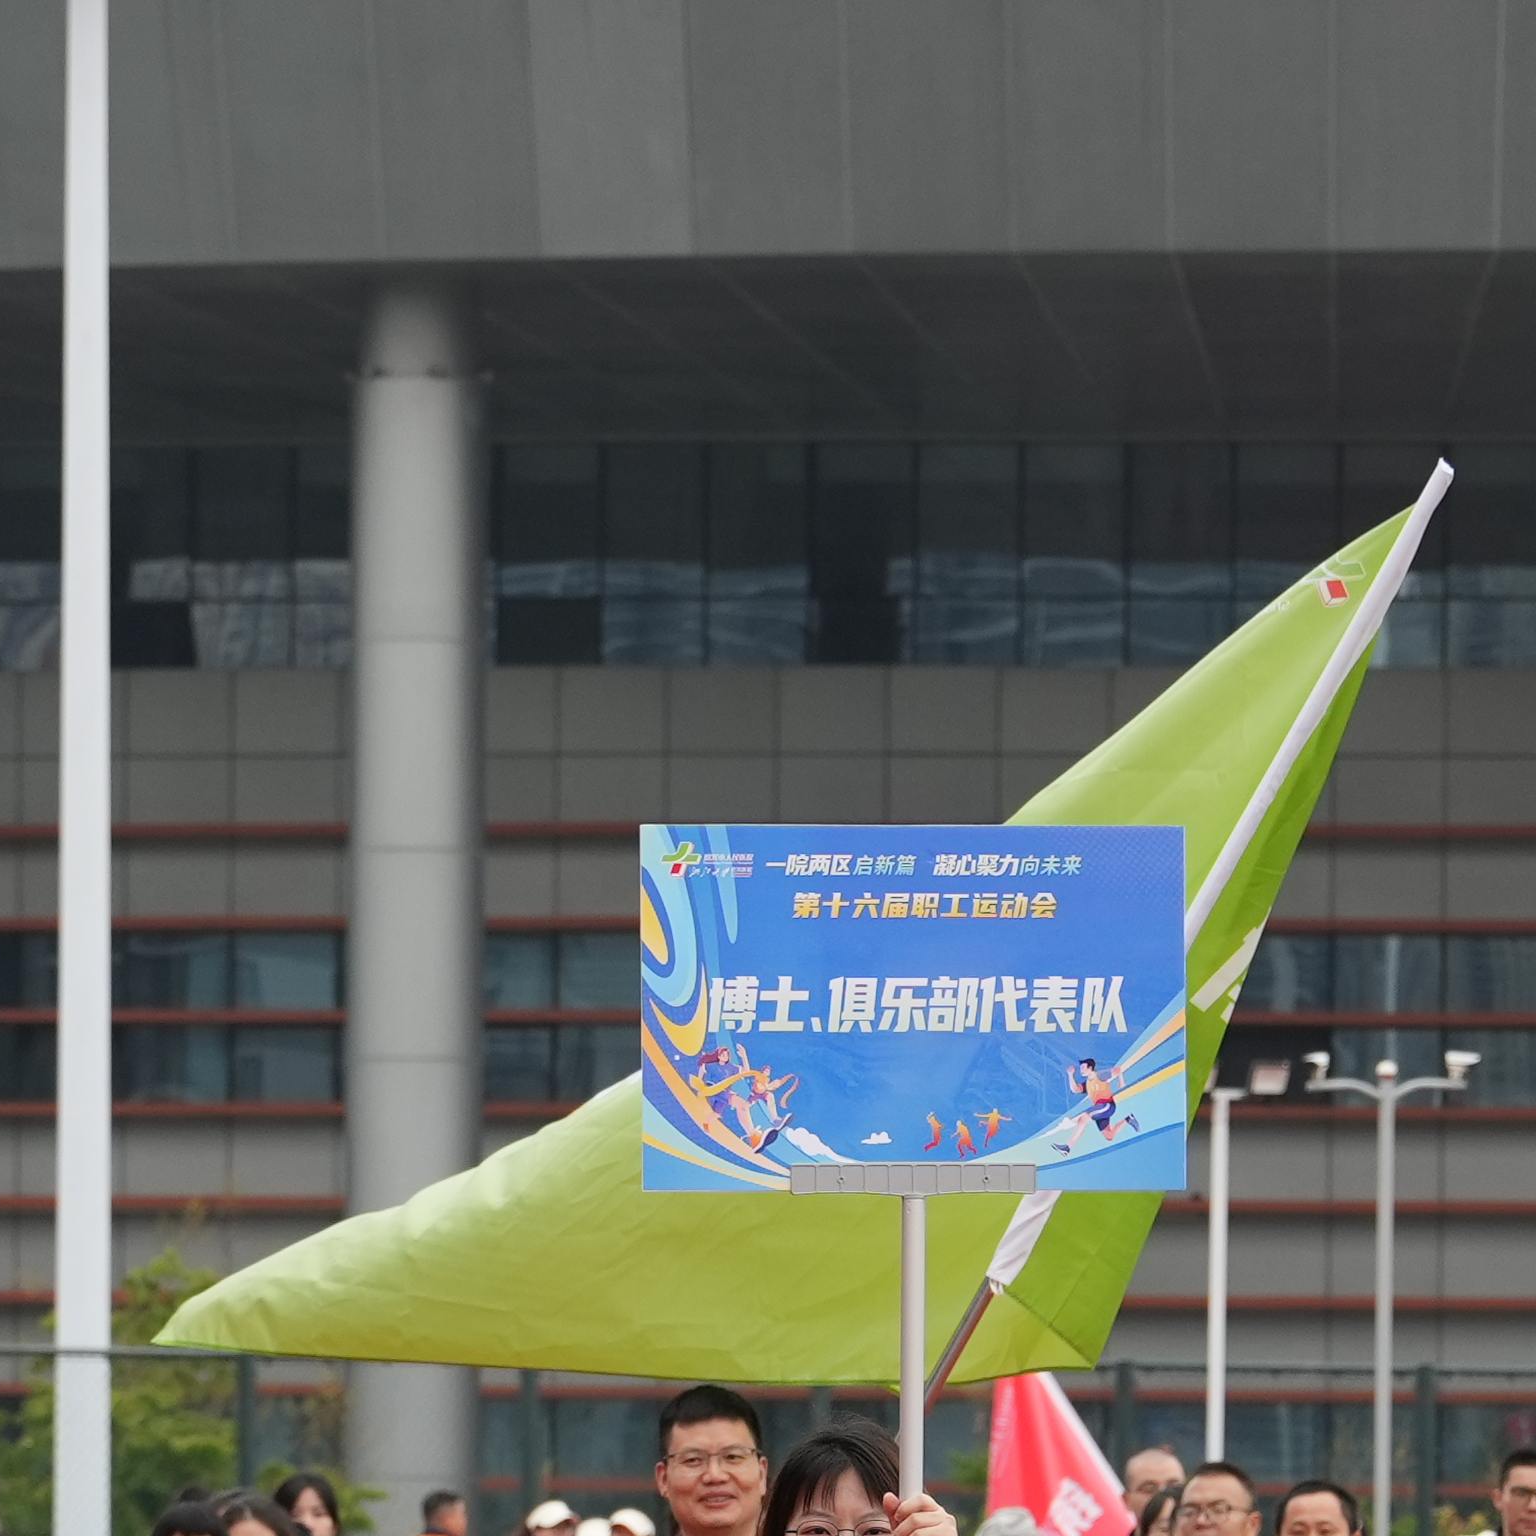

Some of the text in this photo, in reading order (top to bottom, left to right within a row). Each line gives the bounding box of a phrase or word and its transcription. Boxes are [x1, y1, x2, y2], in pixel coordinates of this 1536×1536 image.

[765, 854, 917, 877] 一院两区启新篇
[932, 854, 1083, 877] 凝心聚力向未来
[791, 892, 1059, 919] 第十六届职工运动会
[707, 975, 1128, 1034] 博士、俱乐部代表队
